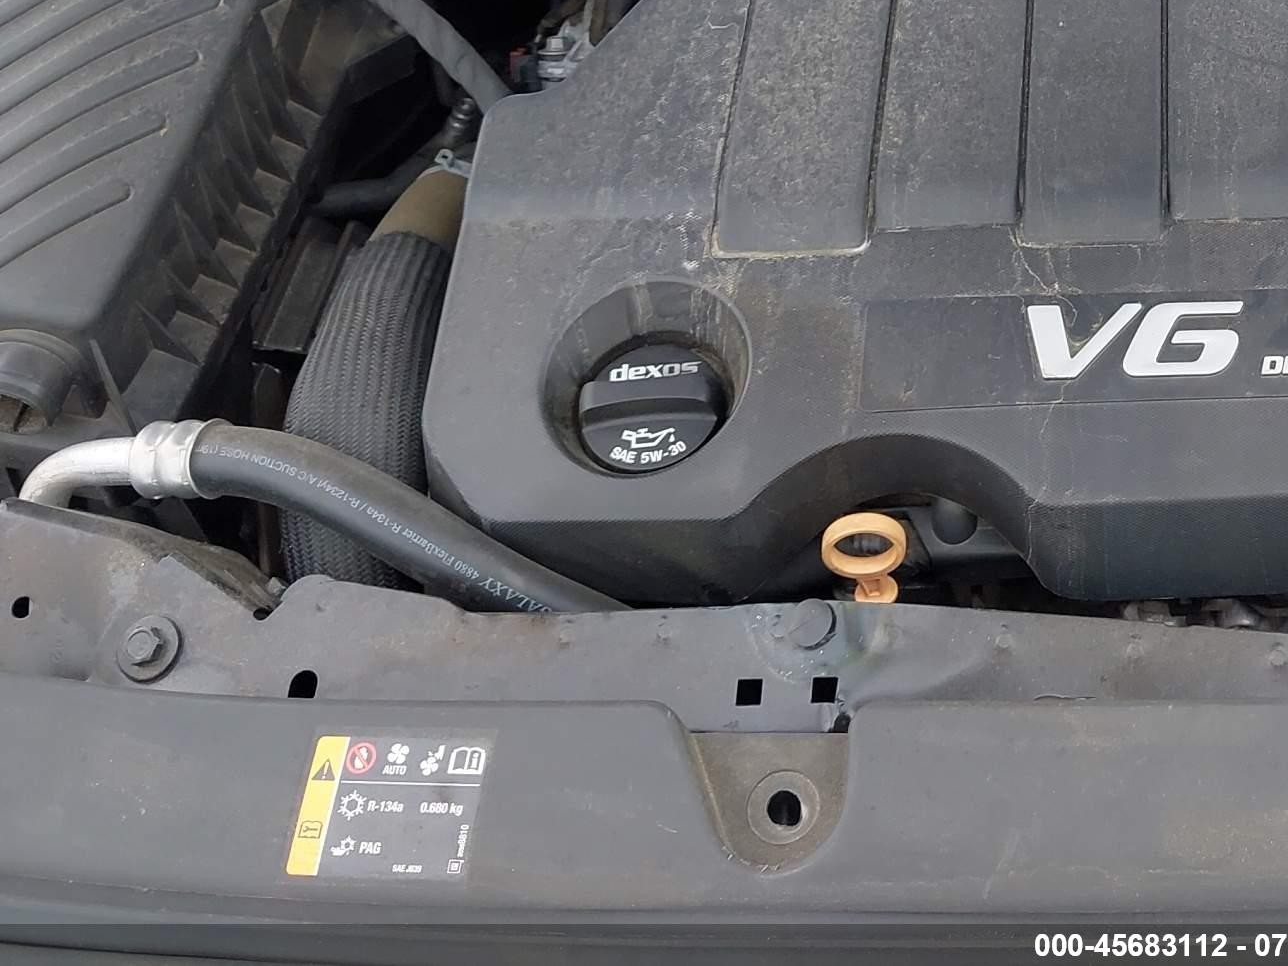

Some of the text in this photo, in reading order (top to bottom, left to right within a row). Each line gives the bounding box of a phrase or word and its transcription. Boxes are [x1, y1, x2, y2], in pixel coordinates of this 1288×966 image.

[1026, 300, 1243, 378] V6
[609, 360, 702, 382] dexos
[219, 447, 250, 460] HOSE
[609, 441, 687, 464] SAE 5W-30
[250, 453, 298, 476] SUCTION
[366, 506, 402, 534] R-134a
[402, 527, 456, 566] FlexBarrier
[454, 560, 480, 581] 4880
[382, 765, 407, 776] AUTO
[367, 800, 464, 817] R-134a 0.680 kg
[358, 841, 383, 854] PAG
